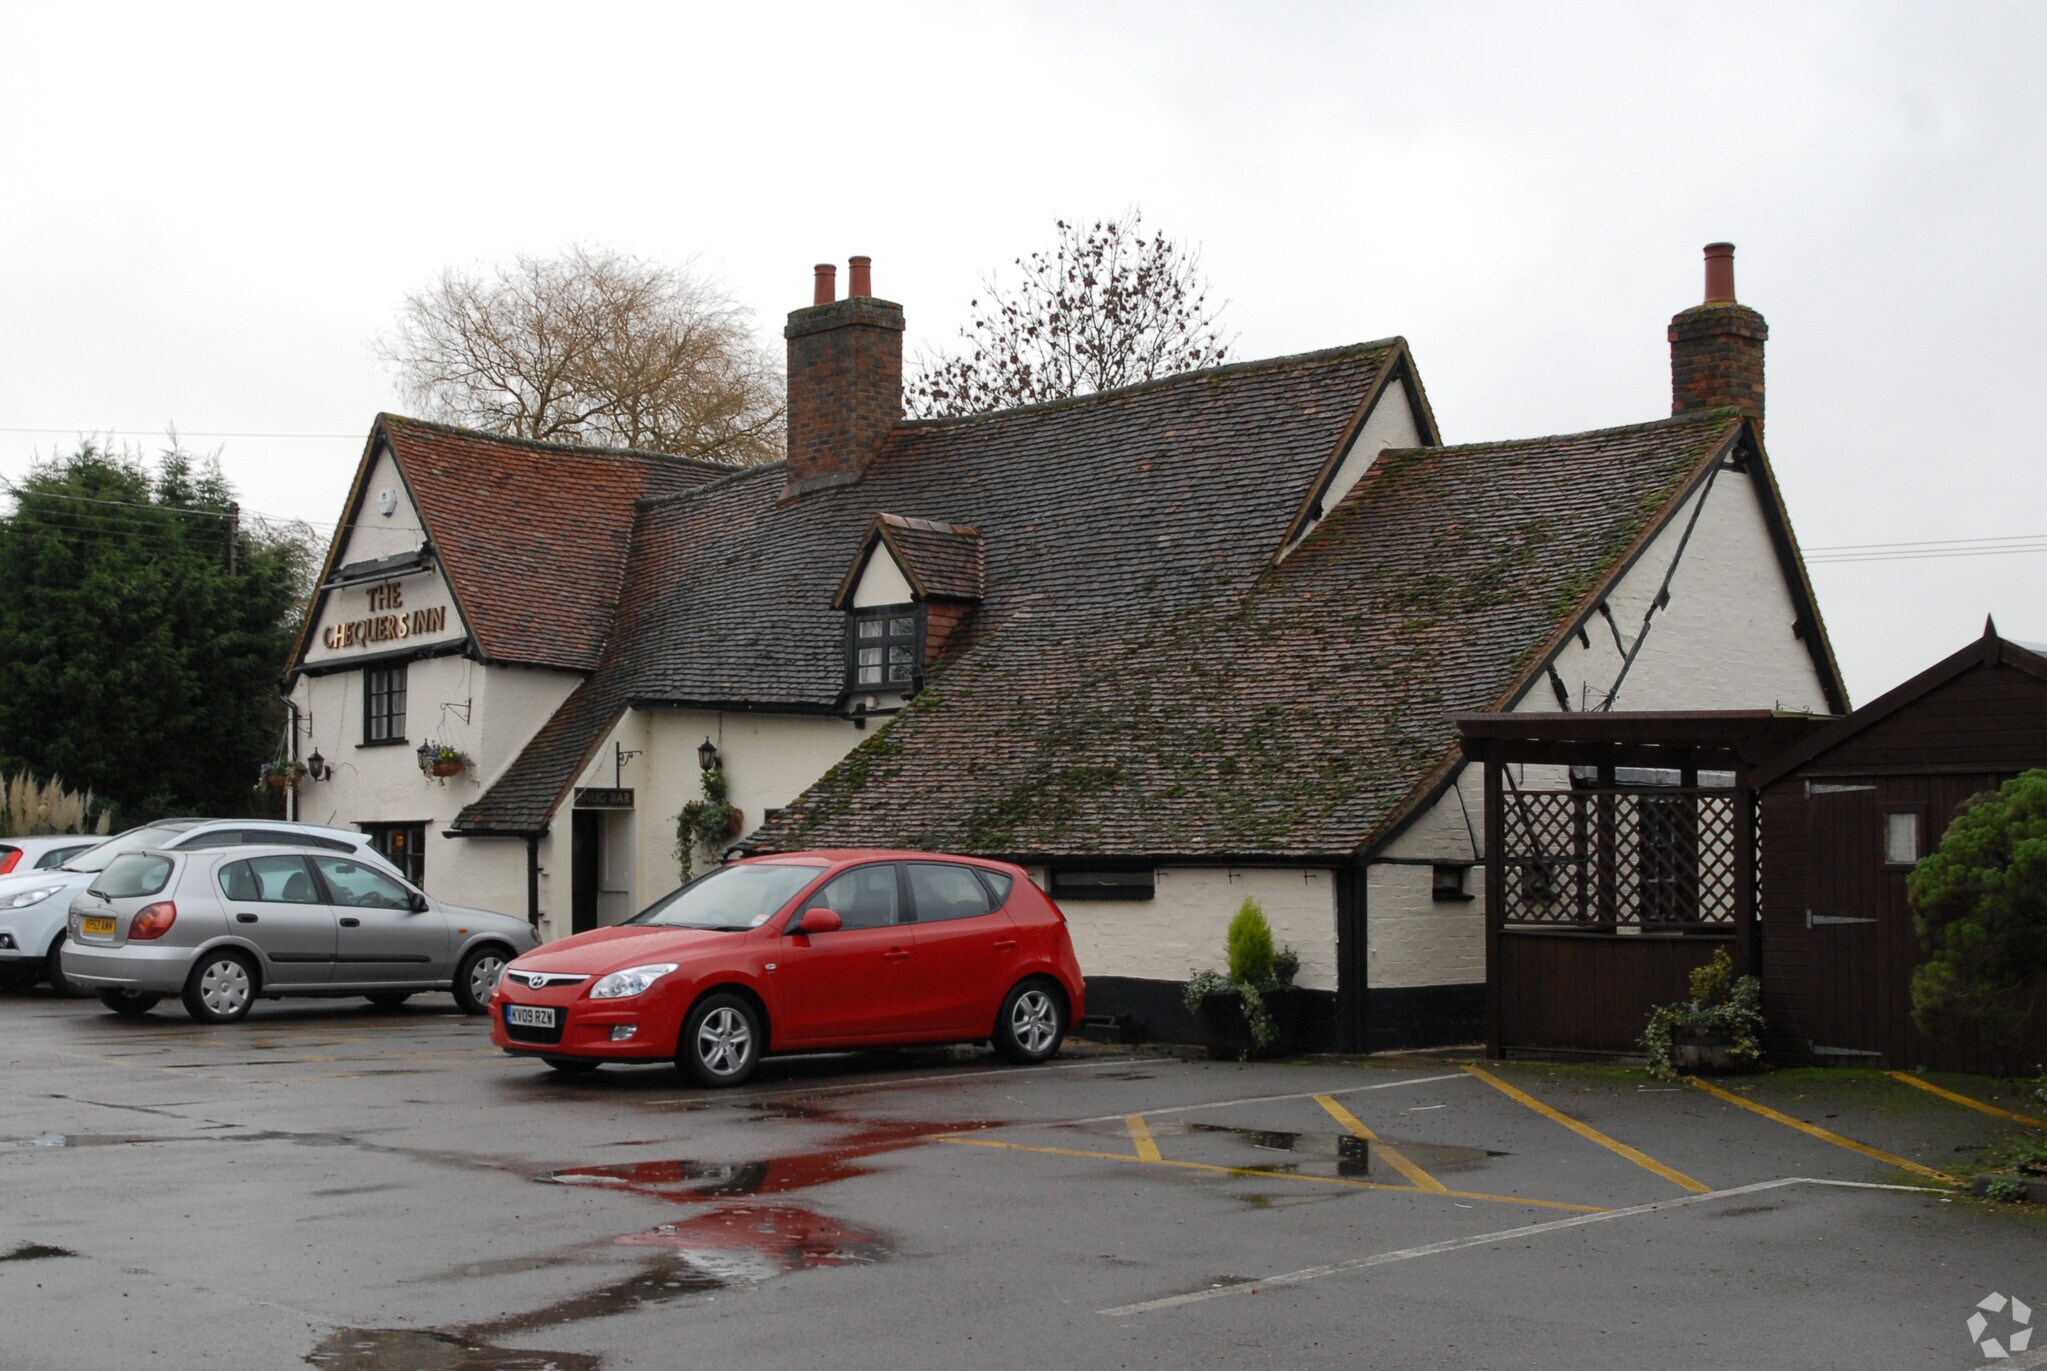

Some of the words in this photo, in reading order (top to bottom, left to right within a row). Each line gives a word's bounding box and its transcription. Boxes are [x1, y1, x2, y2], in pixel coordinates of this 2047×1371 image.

[367, 582, 403, 612] THE
[323, 613, 409, 649] CHEQUERS
[413, 605, 446, 635] INN
[610, 792, 631, 804] BAR
[511, 1008, 533, 1023] KV09
[535, 1010, 553, 1025] RZW
